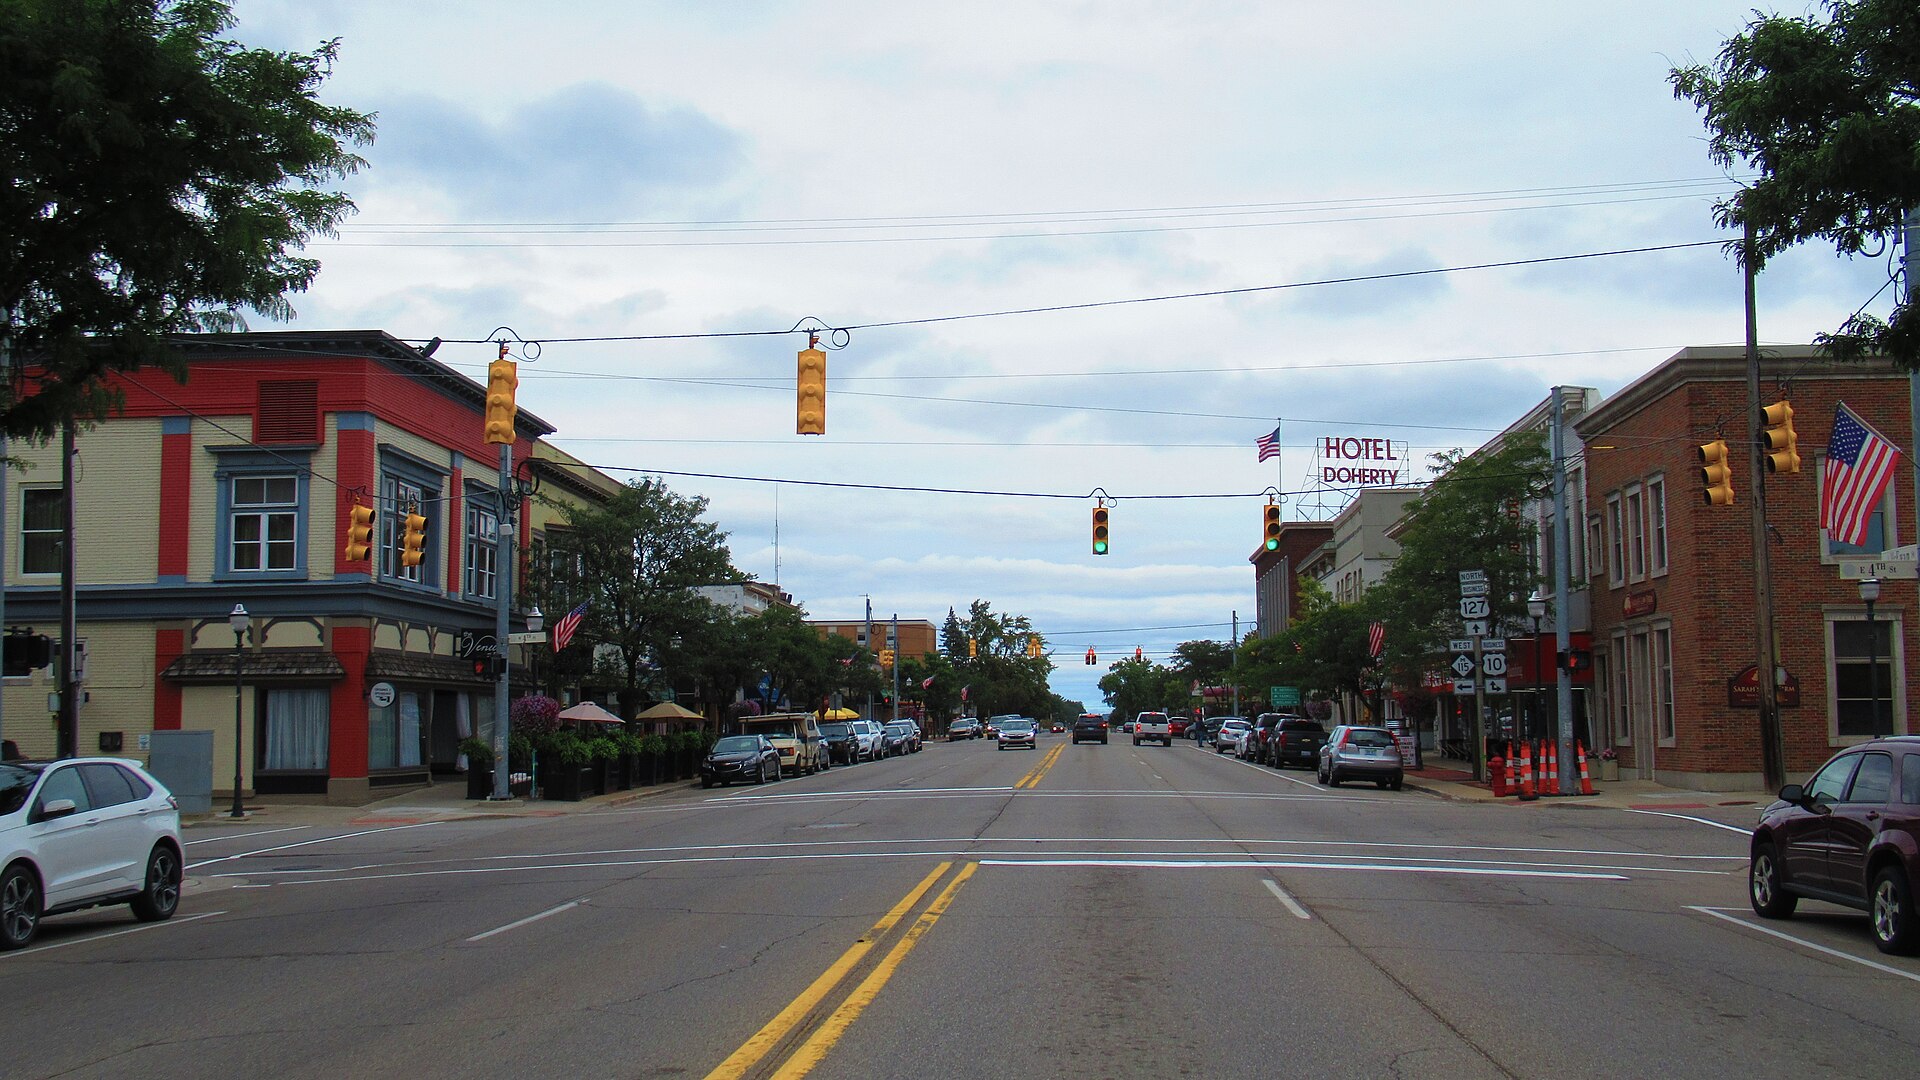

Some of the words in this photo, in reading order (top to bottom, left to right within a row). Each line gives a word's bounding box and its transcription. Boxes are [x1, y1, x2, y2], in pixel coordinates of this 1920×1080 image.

[1325, 437, 1397, 460] HOTEL
[1323, 467, 1399, 486] DOHERTY
[1461, 572, 1483, 580] NORTH
[1868, 562, 1886, 576] 4TH
[1888, 565, 1896, 573] St
[1463, 600, 1485, 614] 127
[1457, 663, 1469, 671] 115
[1487, 658, 1502, 671] 10
